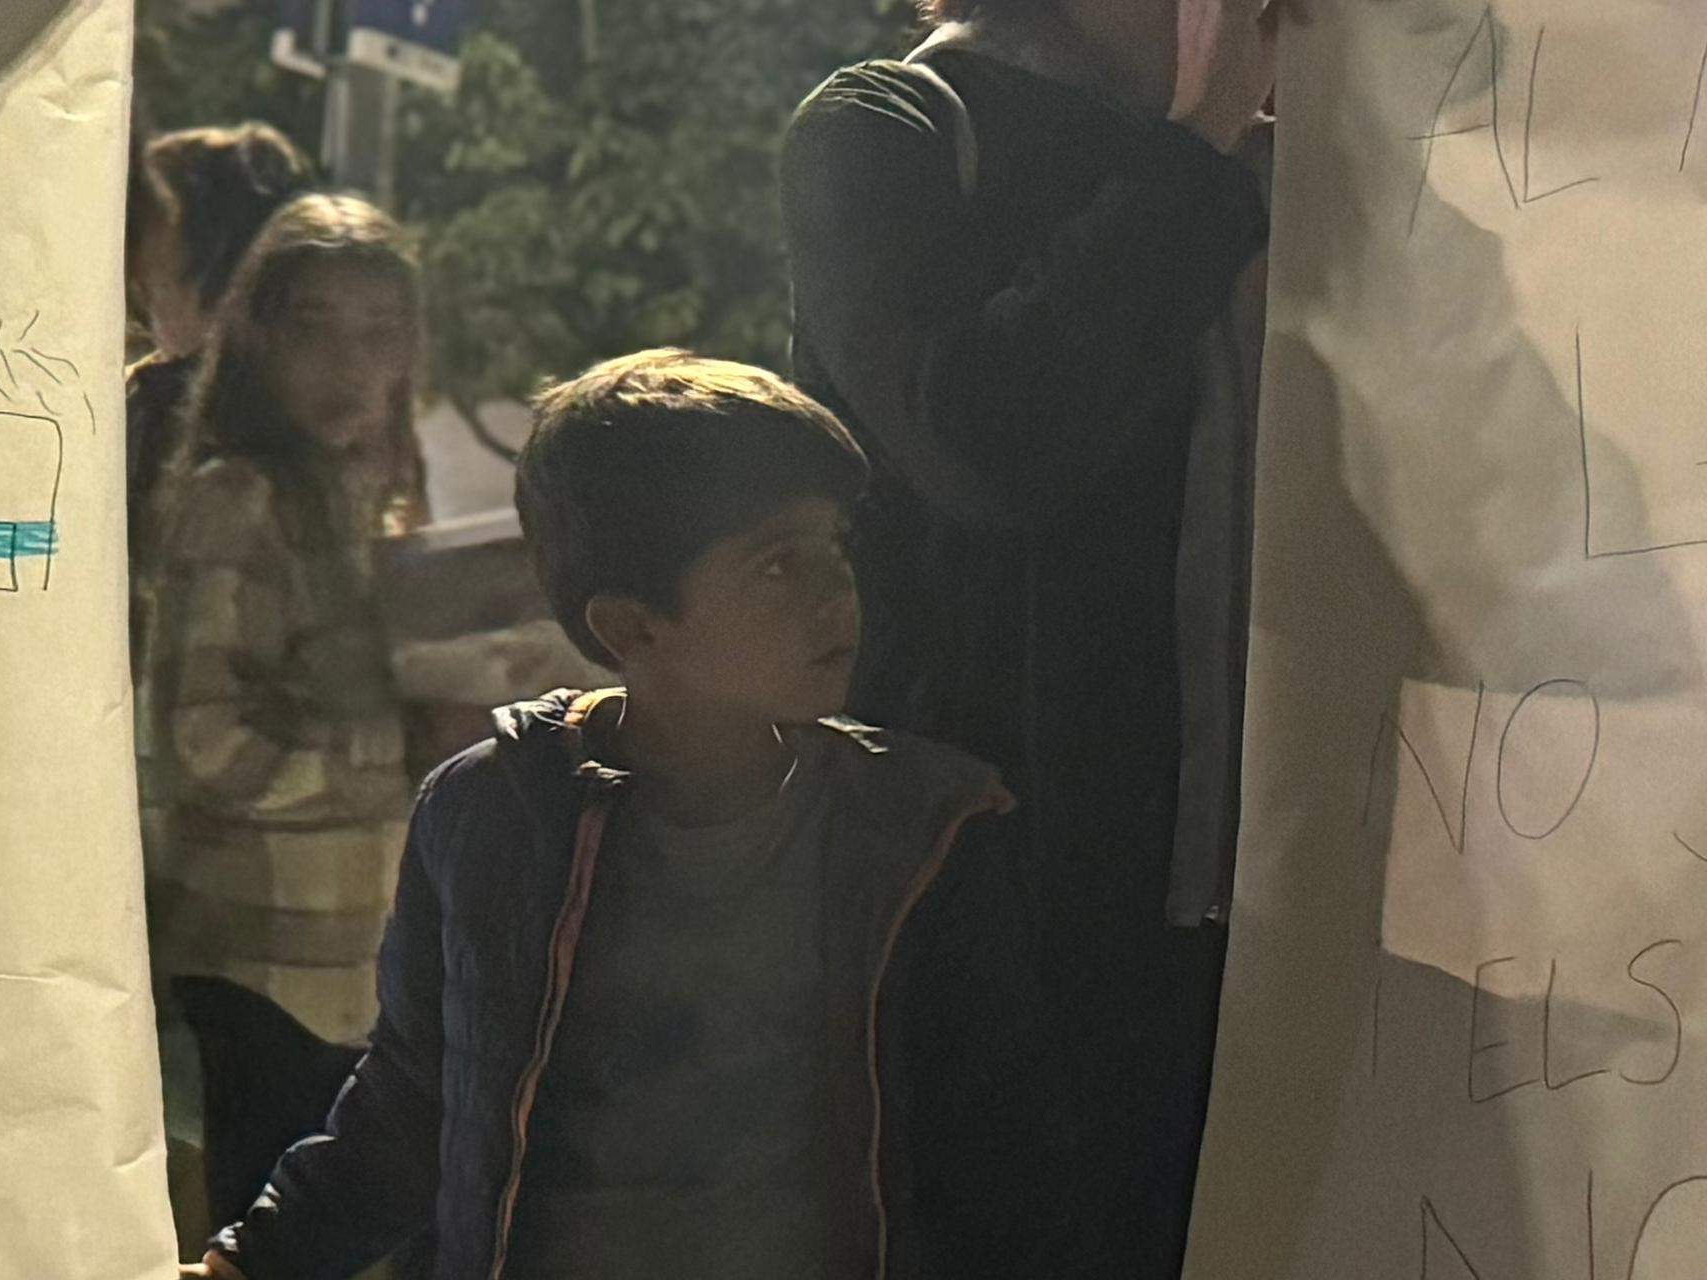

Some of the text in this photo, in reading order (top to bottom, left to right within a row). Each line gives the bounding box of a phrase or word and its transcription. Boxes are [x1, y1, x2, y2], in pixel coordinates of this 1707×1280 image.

[1405, 2, 1601, 238] AL
[1362, 677, 1600, 856] NO
[1468, 938, 1683, 1104] ELS
